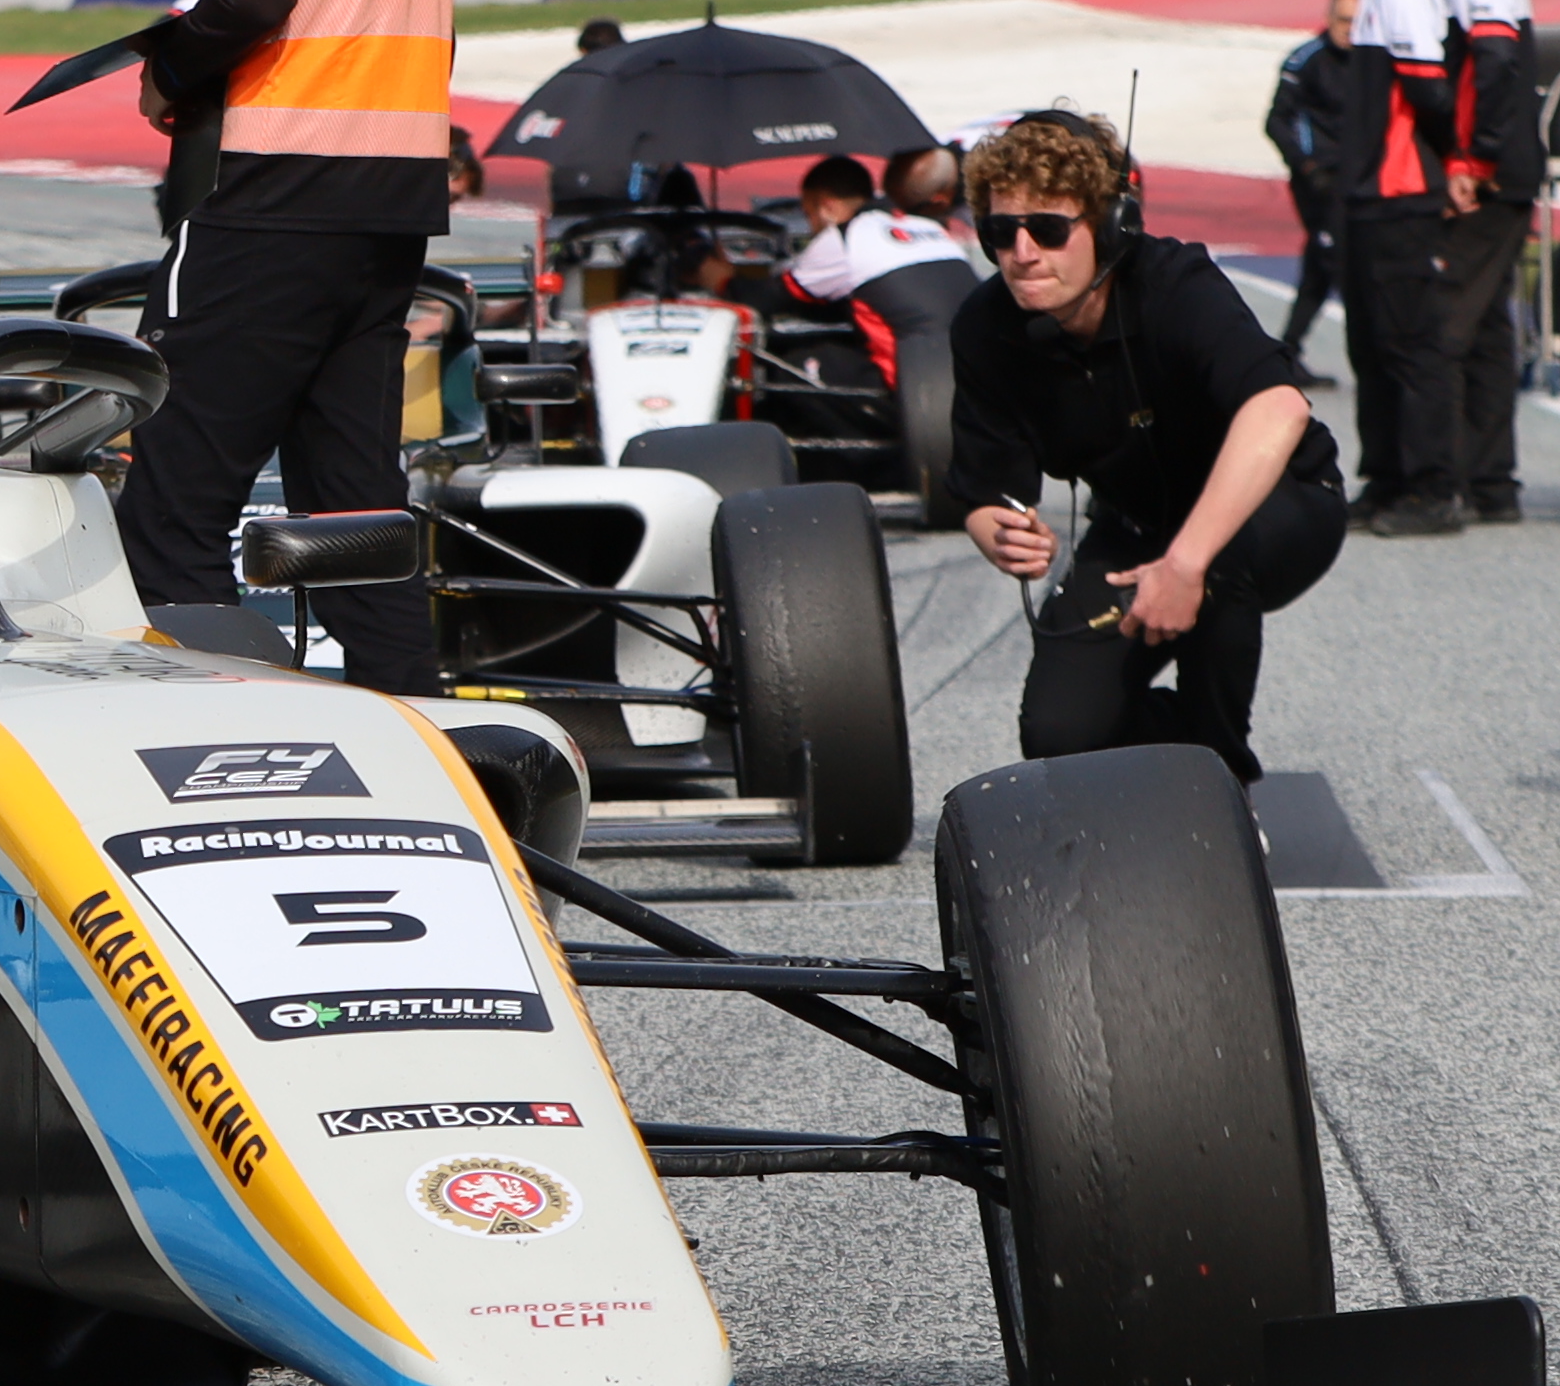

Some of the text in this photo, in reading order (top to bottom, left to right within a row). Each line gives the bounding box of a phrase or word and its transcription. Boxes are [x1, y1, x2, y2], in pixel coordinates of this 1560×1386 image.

[195, 749, 335, 773] F4
[178, 780, 306, 791] CHAMPIONSHIP
[184, 769, 314, 786] CEZ
[140, 829, 464, 859] RacingJournal
[271, 889, 428, 948] 5
[339, 998, 523, 1018] TATUUS
[68, 889, 269, 1188] MAFFIRACING
[470, 1301, 654, 1316] CARROSSERIE
[531, 1313, 606, 1328] LCH
